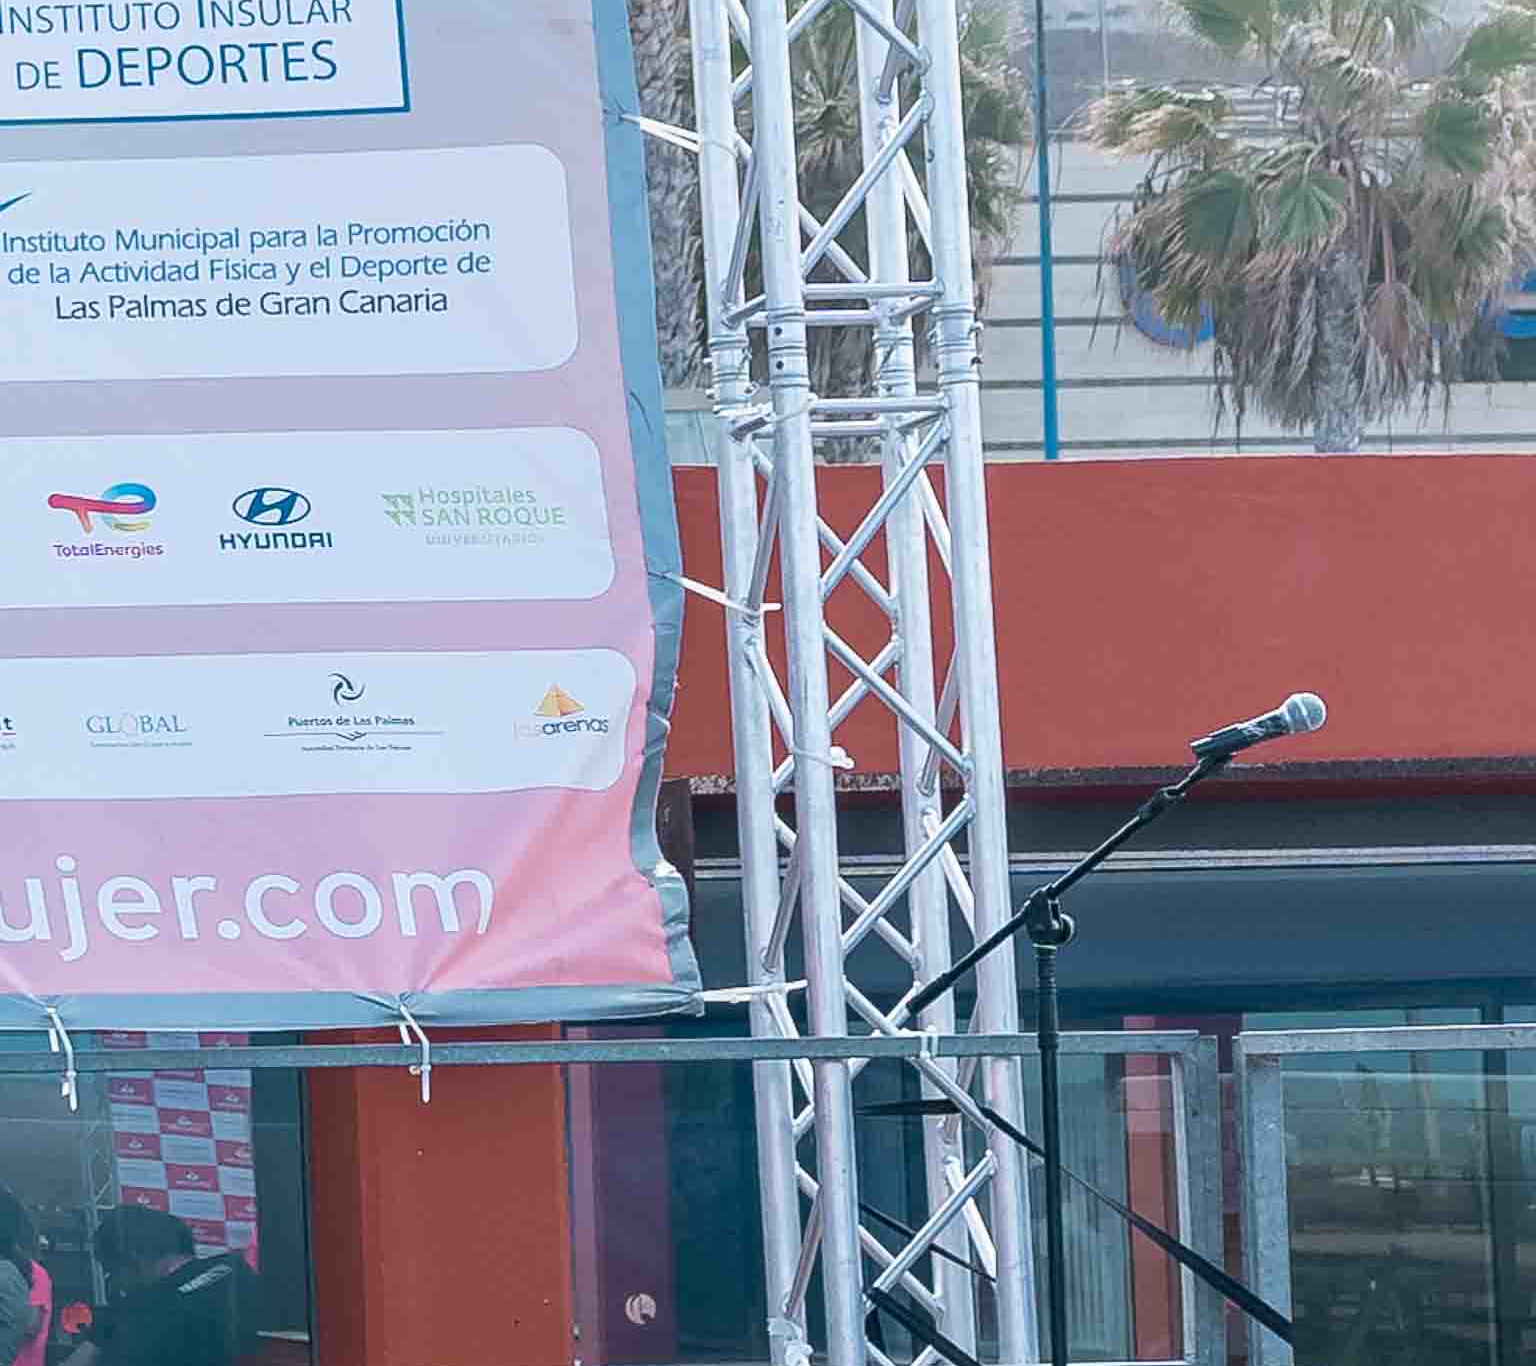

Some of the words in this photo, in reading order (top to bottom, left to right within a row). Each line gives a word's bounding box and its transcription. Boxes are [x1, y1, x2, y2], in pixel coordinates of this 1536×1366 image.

[77, 39, 340, 91] DEPORTES
[2, 229, 106, 253] Instituto
[115, 226, 241, 256] Municipal
[249, 230, 307, 254] para
[316, 224, 338, 247] la
[348, 219, 491, 247] Promoción
[7, 262, 40, 284] de
[49, 262, 71, 284] la
[79, 259, 200, 284] Actividad
[284, 263, 301, 285] y
[309, 256, 331, 278] el
[340, 254, 449, 283] Deporte
[456, 251, 491, 275] de
[55, 295, 101, 321] Las
[109, 293, 208, 319] Palmas
[215, 291, 251, 317] de
[259, 290, 331, 316] Gran
[338, 287, 449, 315] Canaria
[418, 486, 537, 507] Hospitales
[421, 508, 473, 527] SAN
[478, 507, 567, 525] ROQUE
[52, 541, 165, 561] TotalEnergies
[219, 531, 333, 550] HYUNDAI
[85, 713, 188, 737] GLOBAL
[336, 715, 350, 727] de
